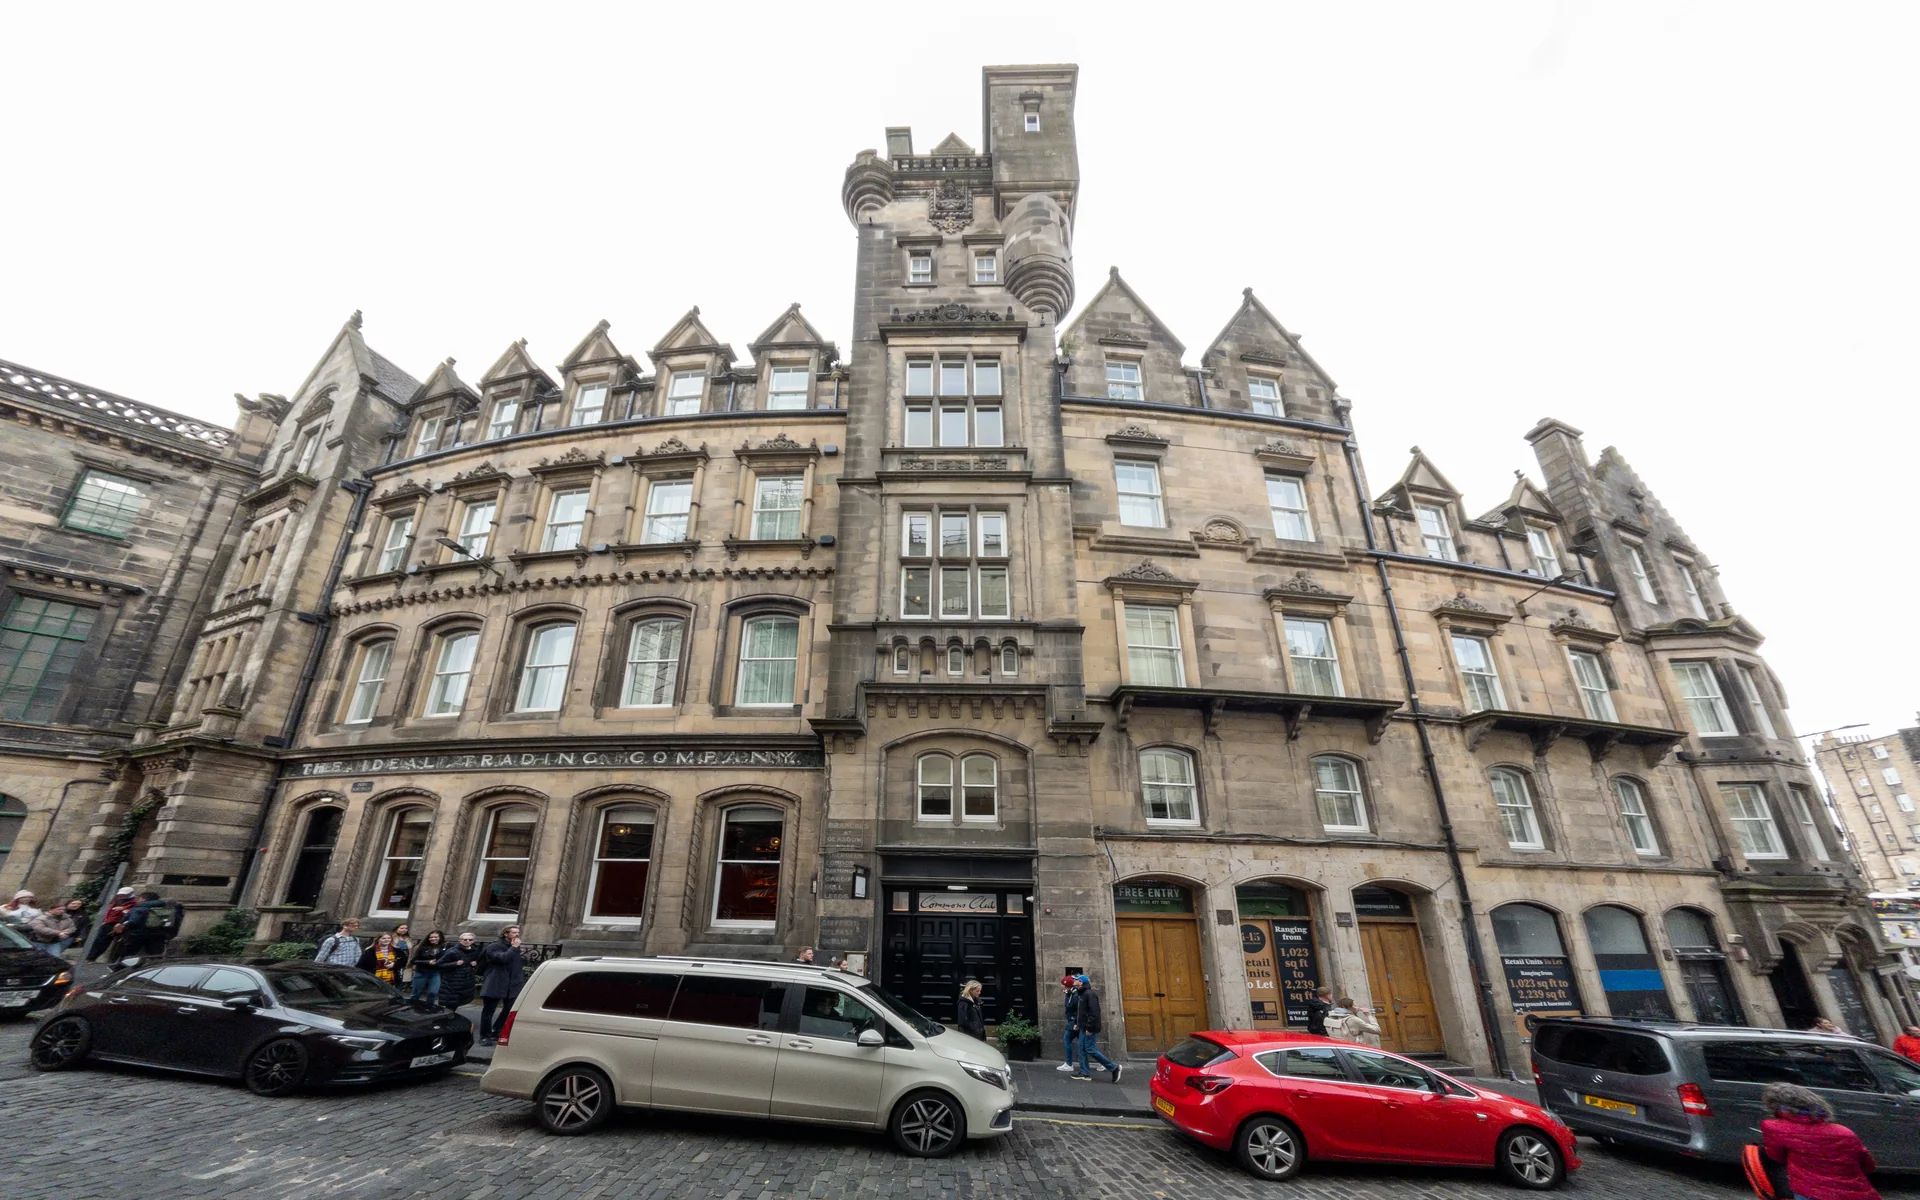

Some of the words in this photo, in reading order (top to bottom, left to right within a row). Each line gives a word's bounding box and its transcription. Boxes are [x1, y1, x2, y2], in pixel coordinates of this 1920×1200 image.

[302, 761, 343, 776] THE
[361, 756, 435, 771] IDEAL
[462, 752, 598, 767] TRADING
[1119, 887, 1144, 897] FREE
[1147, 888, 1180, 898] ENTRY
[920, 894, 966, 909] Commons
[968, 895, 996, 910] Club
[1274, 926, 1308, 934] Ranging
[1280, 947, 1309, 958] 1,023
[1245, 958, 1271, 967] etail
[1285, 960, 1299, 970] sq
[1299, 959, 1309, 968] ft
[1292, 970, 1304, 978] to
[1247, 981, 1254, 989] o
[1256, 980, 1274, 989] Let
[1285, 980, 1315, 990] 2,239
[1509, 979, 1536, 989] 1,023
[1537, 981, 1549, 989] sq
[1549, 979, 1558, 987] ft
[1559, 980, 1569, 988] to
[1290, 992, 1304, 1002] sq
[1304, 991, 1313, 1000] ft
[1518, 990, 1544, 1000] 2,239
[1546, 991, 1558, 1000] sq
[1558, 990, 1567, 998] ft
